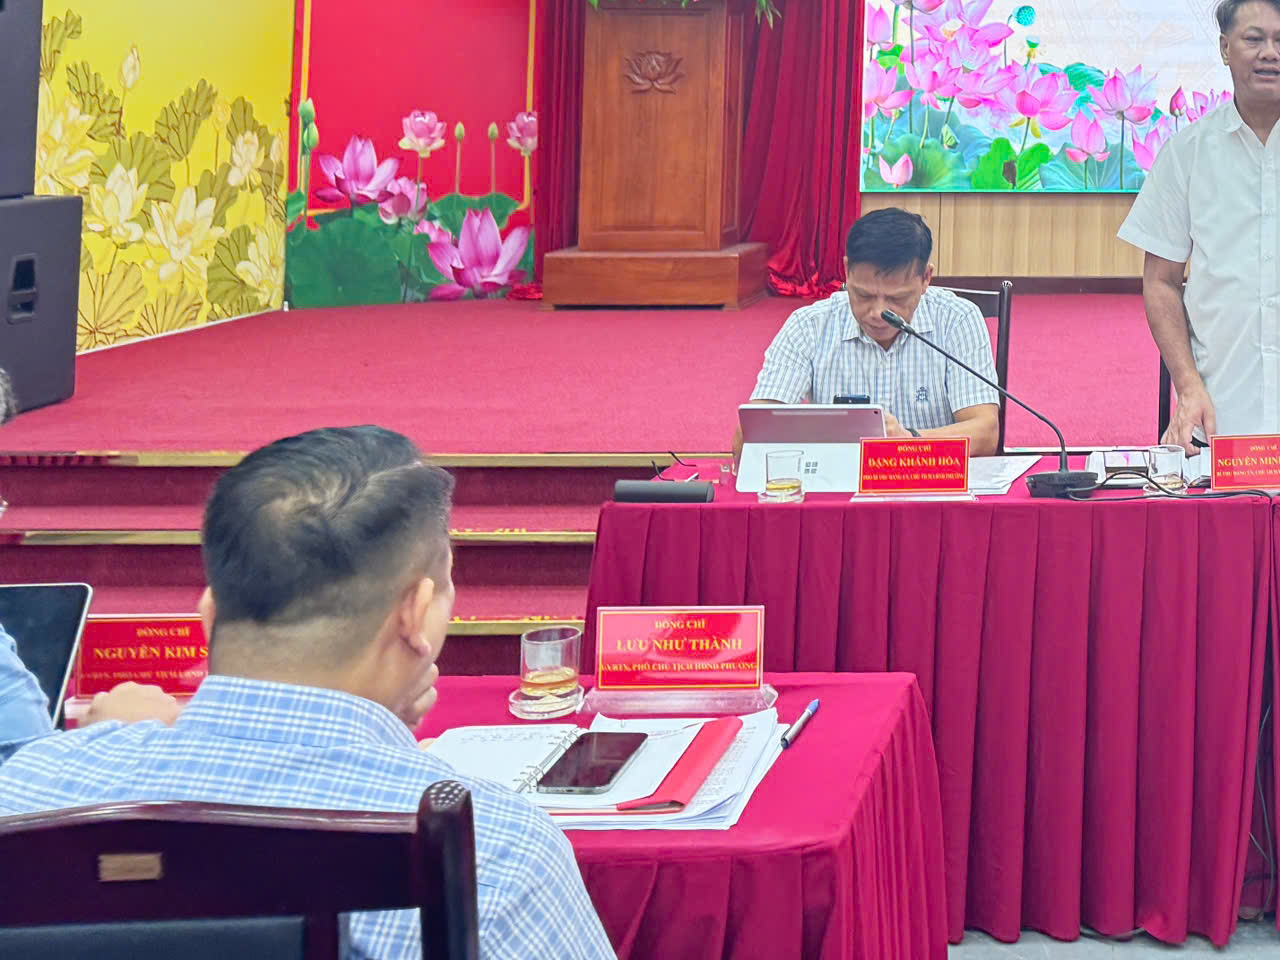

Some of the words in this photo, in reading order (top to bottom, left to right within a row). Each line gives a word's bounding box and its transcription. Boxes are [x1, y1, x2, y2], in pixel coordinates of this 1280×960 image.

[616, 638, 649, 651] LƯU
[652, 637, 688, 651] NHƯ
[688, 635, 743, 651] THÀNH
